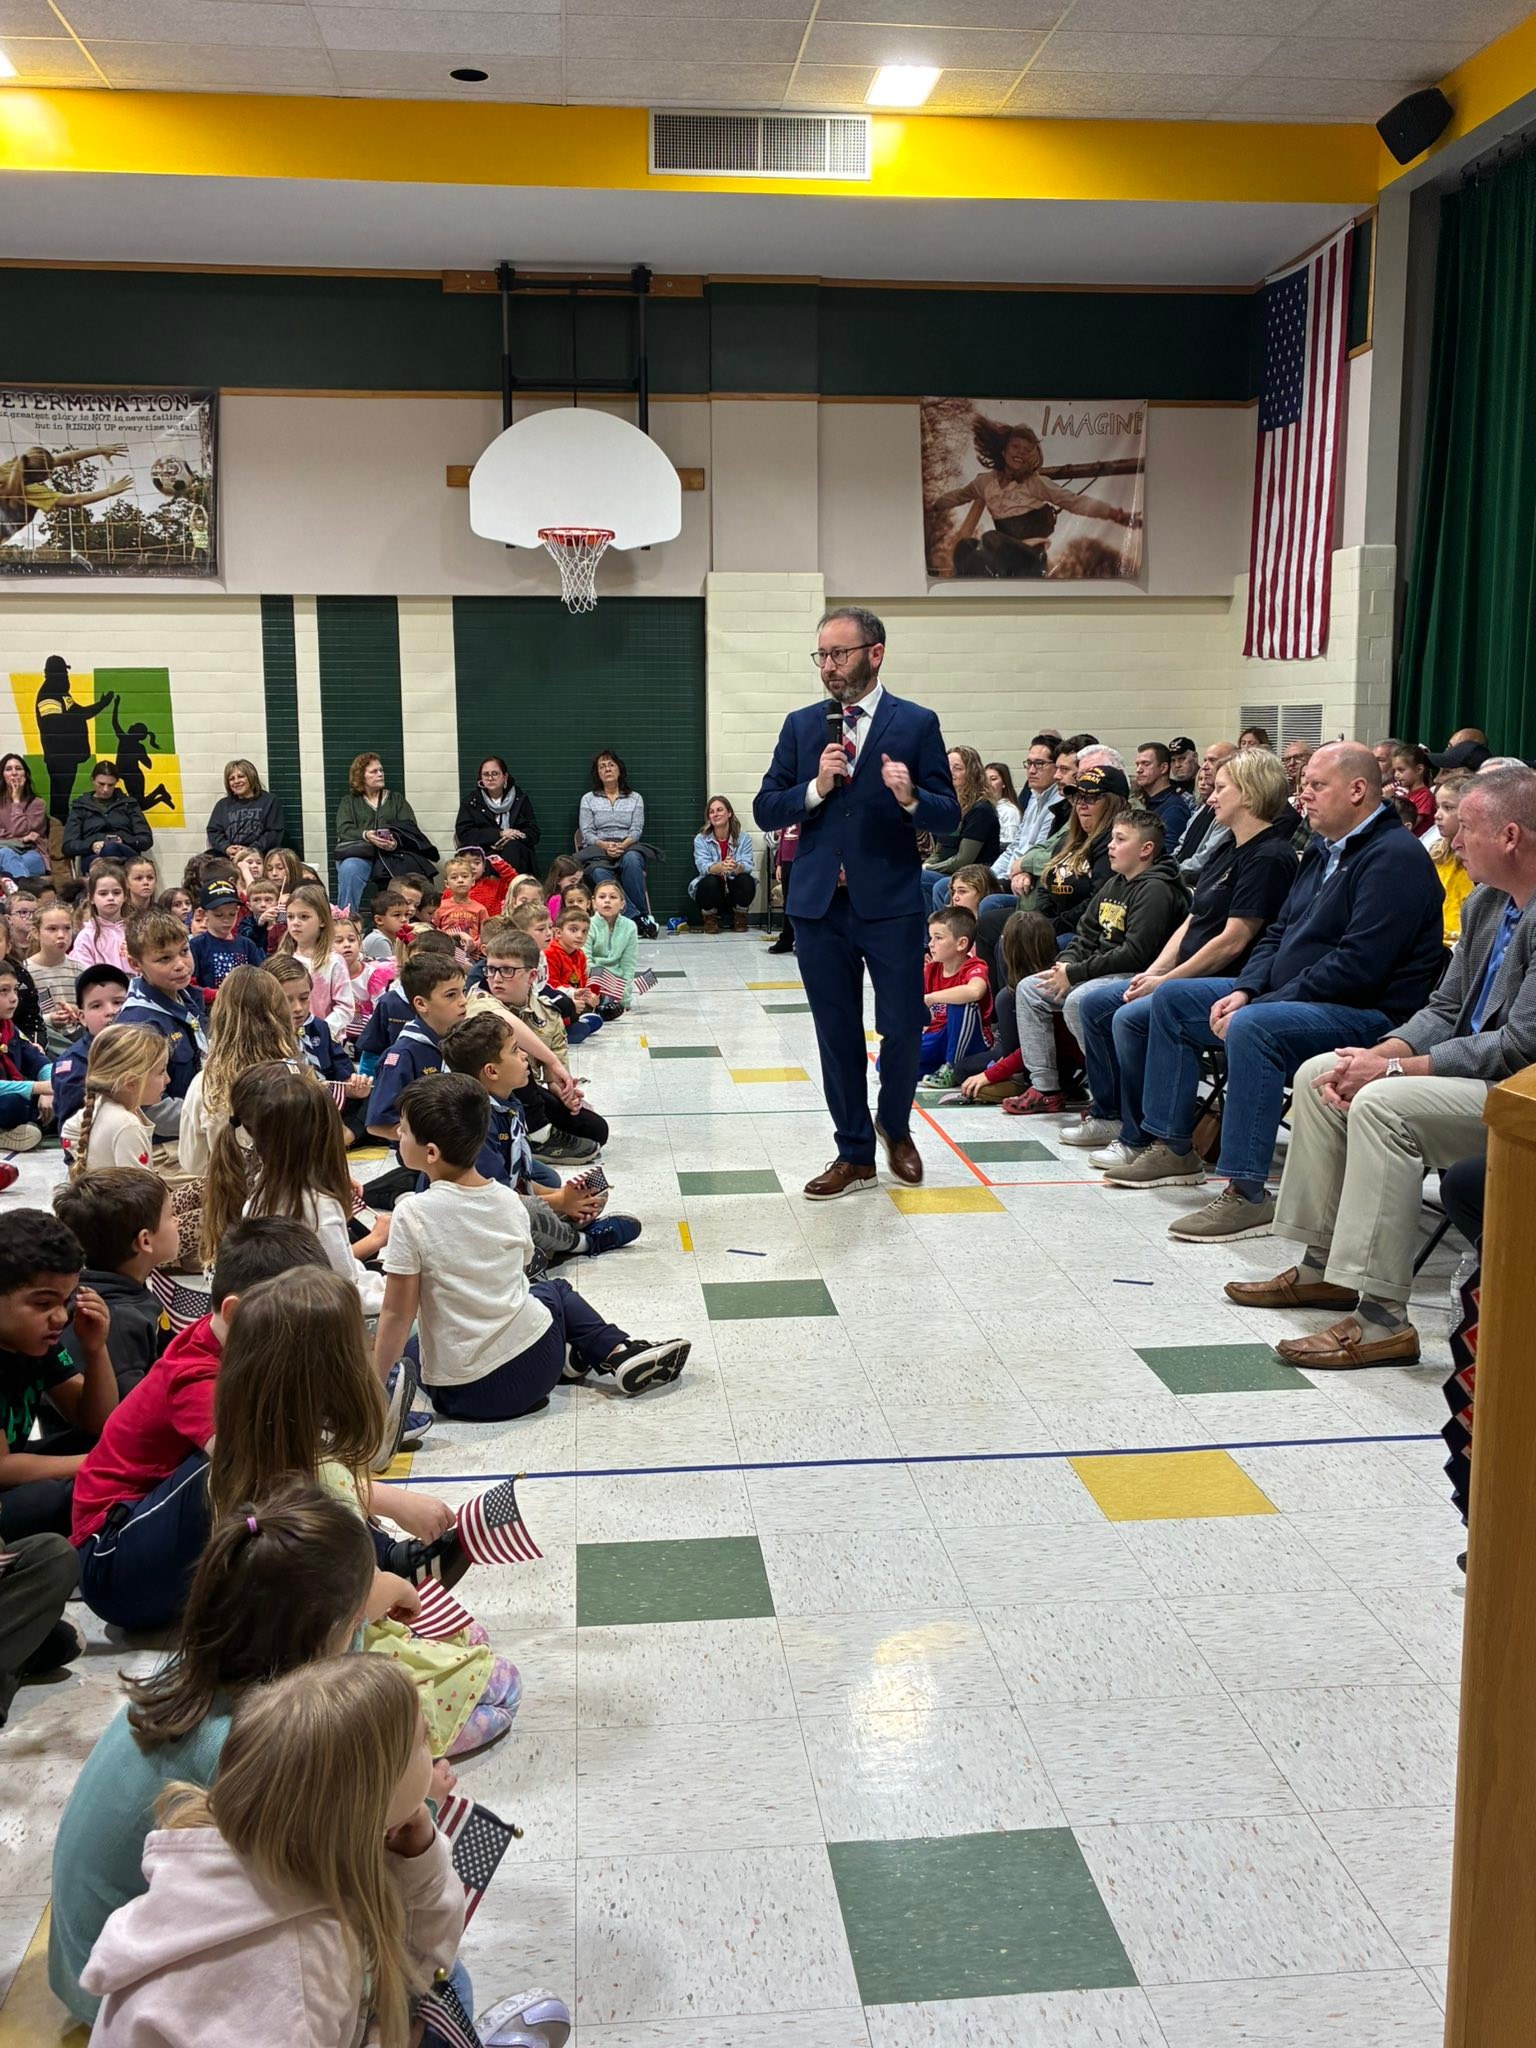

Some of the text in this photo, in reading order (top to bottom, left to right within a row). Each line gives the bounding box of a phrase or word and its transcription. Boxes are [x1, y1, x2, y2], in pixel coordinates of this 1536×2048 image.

[10, 411, 50, 419] greatest
[51, 412, 78, 422] glory
[79, 413, 90, 421] is
[92, 413, 111, 421] NOT
[114, 414, 124, 422] in
[1041, 405, 1143, 438] IMAGINE
[35, 422, 51, 430] but
[53, 422, 63, 430] in
[65, 423, 101, 431] RISING
[103, 423, 117, 431] UP
[145, 423, 165, 431] time
[227, 808, 263, 823] WEST
